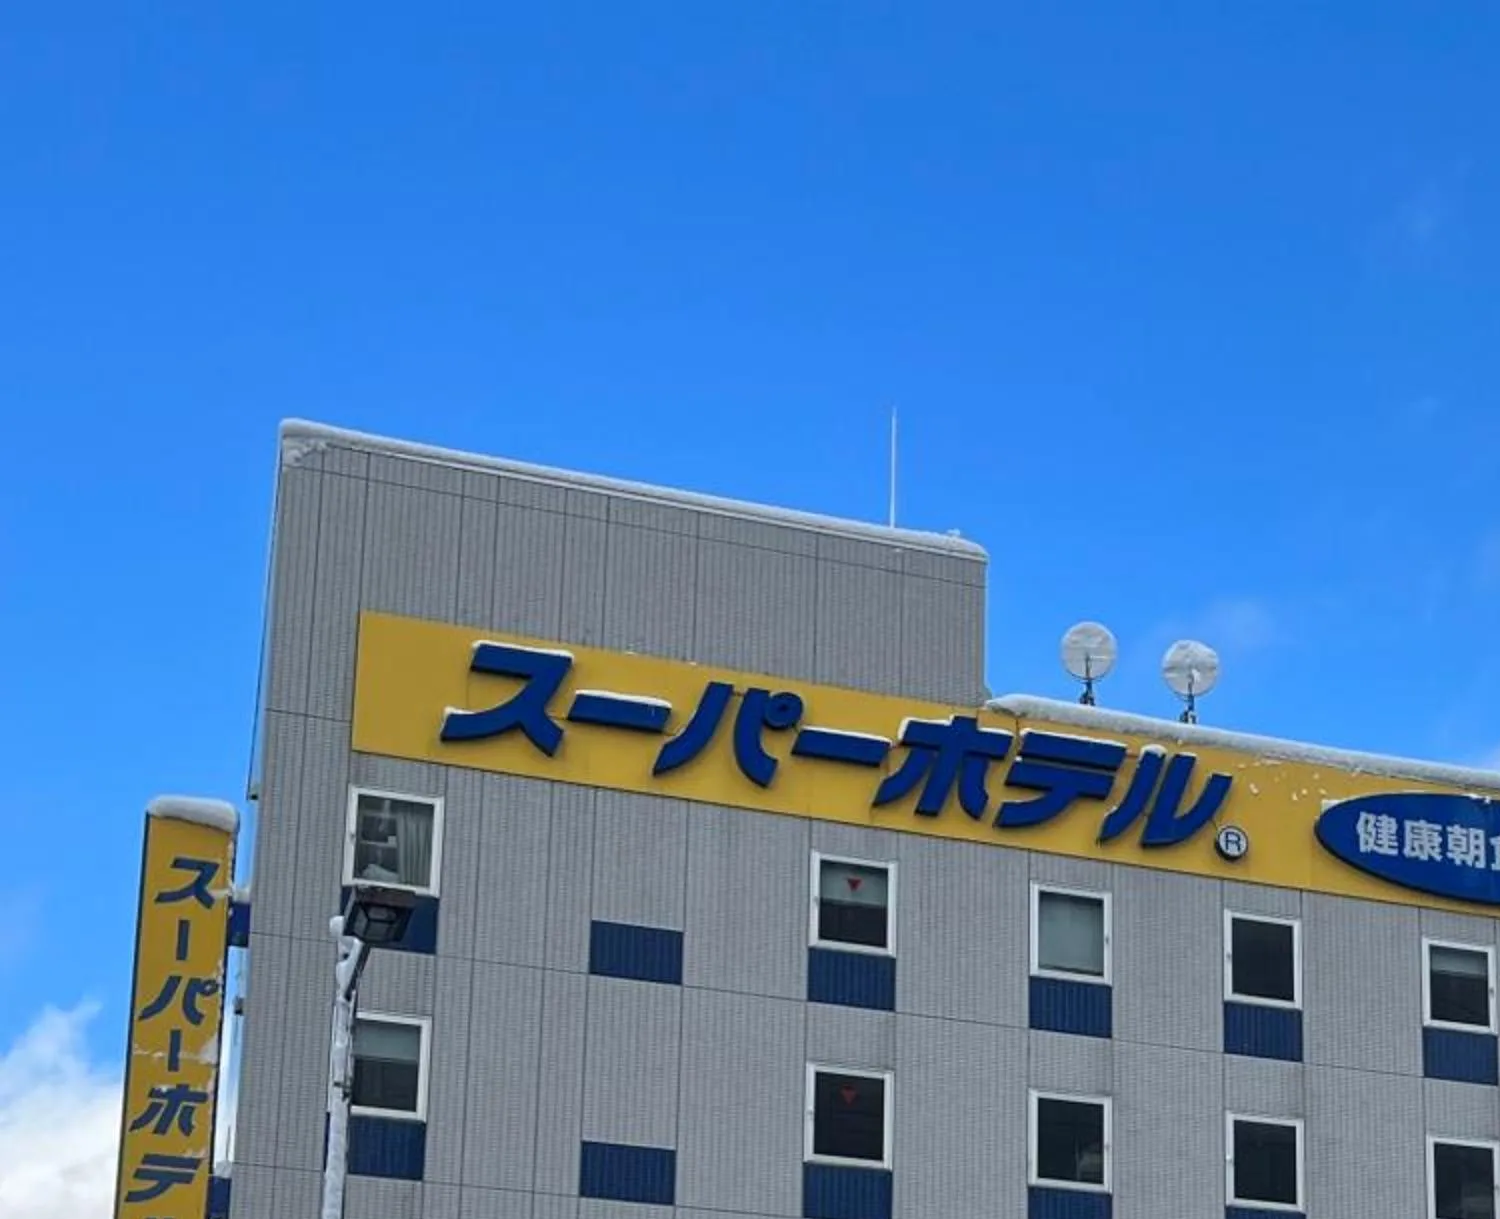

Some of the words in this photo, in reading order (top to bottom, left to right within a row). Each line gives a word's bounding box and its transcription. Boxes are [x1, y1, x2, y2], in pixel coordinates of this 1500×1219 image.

[441, 641, 1234, 850] スーパーホテル
